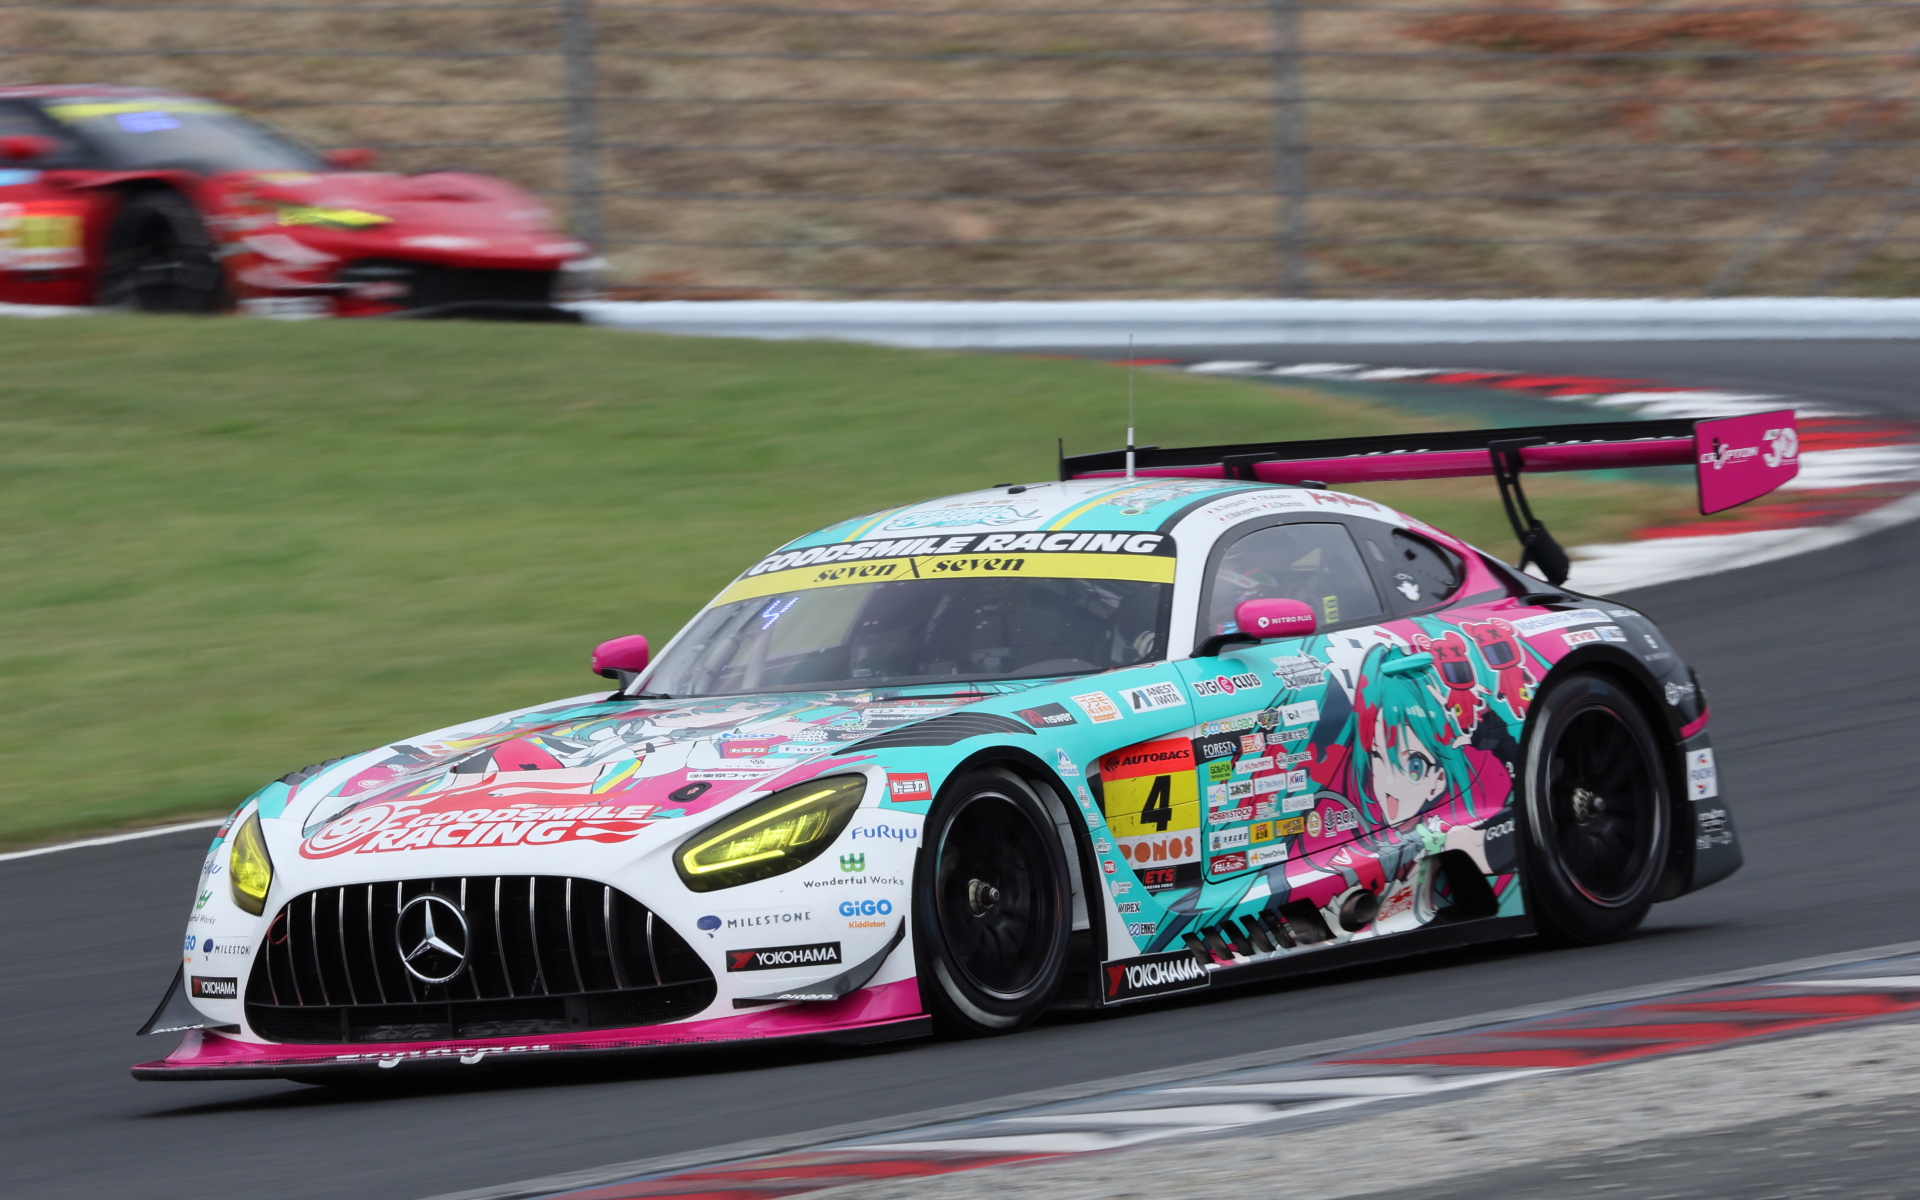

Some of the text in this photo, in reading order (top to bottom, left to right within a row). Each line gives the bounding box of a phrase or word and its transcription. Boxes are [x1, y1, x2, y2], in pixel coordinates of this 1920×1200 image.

[748, 533, 1163, 576] GOODSMILE RACING
[814, 562, 898, 583] seven
[931, 555, 1026, 574] seven
[1146, 684, 1177, 698] ANEST
[1156, 692, 1183, 707] IWATA
[1121, 749, 1190, 767] AUTOBACS
[891, 777, 930, 796] トミカ
[1289, 773, 1305, 786] KWE
[1140, 775, 1172, 832] 4
[410, 804, 657, 827] GOODSMILE
[1335, 809, 1357, 827] BOX
[367, 819, 580, 853] RACING
[851, 824, 918, 843] FuRyu
[803, 874, 905, 889] Wonderful Works
[1145, 868, 1175, 884] ETS
[838, 898, 893, 918] GiGO
[727, 910, 811, 929] MILESTONE
[848, 919, 886, 929] Kiddleton
[755, 946, 838, 966] YOKOHAMA
[1125, 957, 1205, 990] YOKOHAMA
[200, 980, 237, 995] YOKOHAMA
